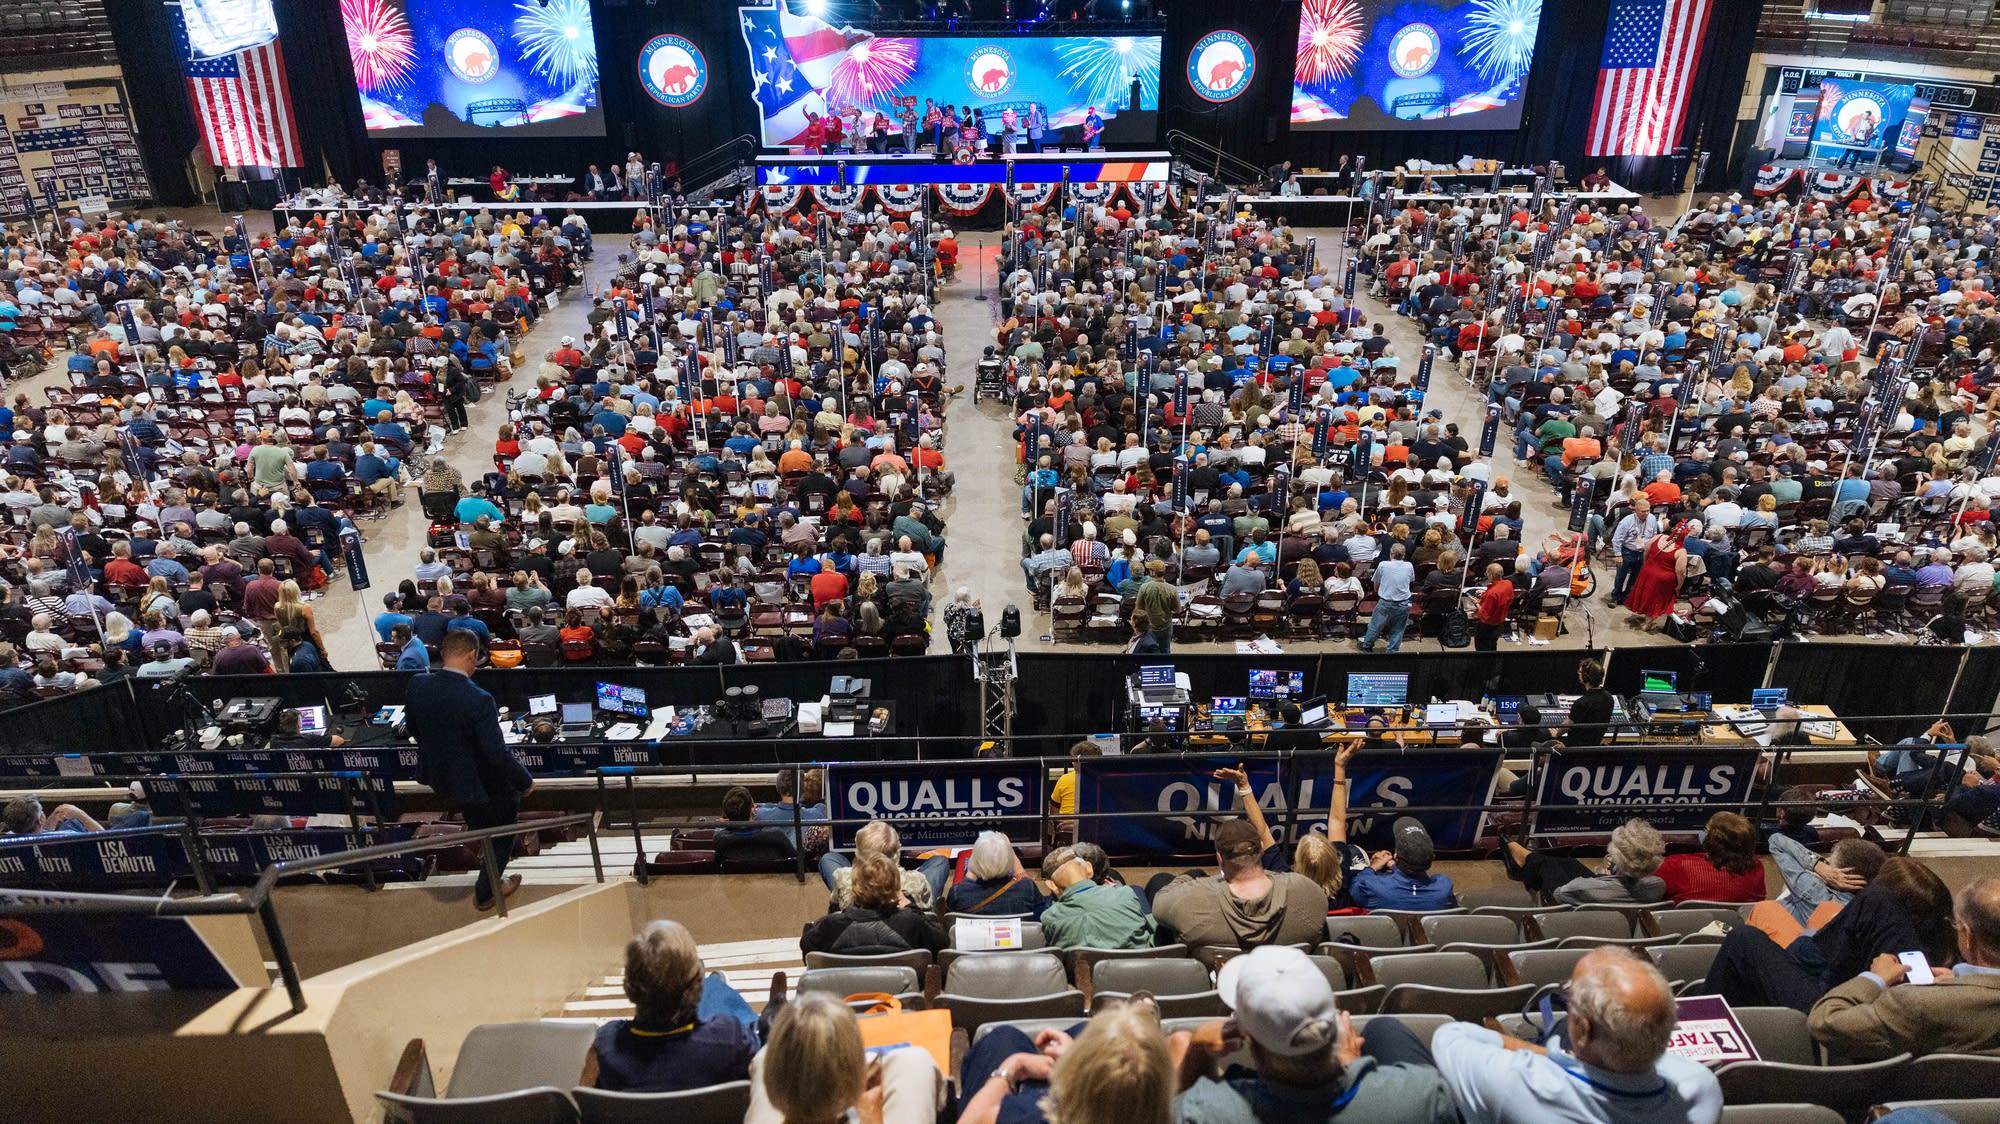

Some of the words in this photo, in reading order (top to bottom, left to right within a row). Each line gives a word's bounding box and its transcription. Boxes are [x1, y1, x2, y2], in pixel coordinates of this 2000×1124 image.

[645, 37, 696, 55] MINNESOTA
[1197, 33, 1247, 52] MINNESOTA
[970, 47, 1010, 61] MINNESOTA
[647, 82, 686, 103] REPUBLICAN
[686, 82, 702, 100] PARTY
[1193, 78, 1230, 98] REPUBLICAN
[1231, 76, 1248, 95] PARTY
[1842, 90, 1885, 108] MINNESOTA
[60, 108, 82, 117] TAFOYA
[106, 120, 128, 129] TAFOYA
[86, 135, 109, 146] TAFOYA
[53, 154, 77, 163] TAFOYA
[82, 165, 105, 175] TAFOYA
[1328, 454, 1348, 464] 47
[175, 754, 196, 763] LISA
[344, 756, 379, 768] DEMUTH
[614, 752, 649, 763] DEMUTH
[178, 760, 214, 772] DEMUTH
[289, 759, 324, 771] DEMUH
[190, 780, 219, 792] WIN!
[235, 779, 272, 791] FIGHT.
[273, 779, 301, 791] WIN!
[319, 778, 356, 791] FIG.
[357, 778, 385, 792] WN!
[1561, 765, 1735, 801] QUALLS
[848, 776, 1024, 815] QUALLS
[1598, 815, 1615, 825] for
[1617, 815, 1675, 825] Miesota
[917, 829, 976, 840] Minnesota
[1185, 817, 1373, 845] NIOLSN
[263, 836, 292, 847] LISA
[97, 841, 128, 858] LISA
[101, 856, 156, 873] DEMUTH
